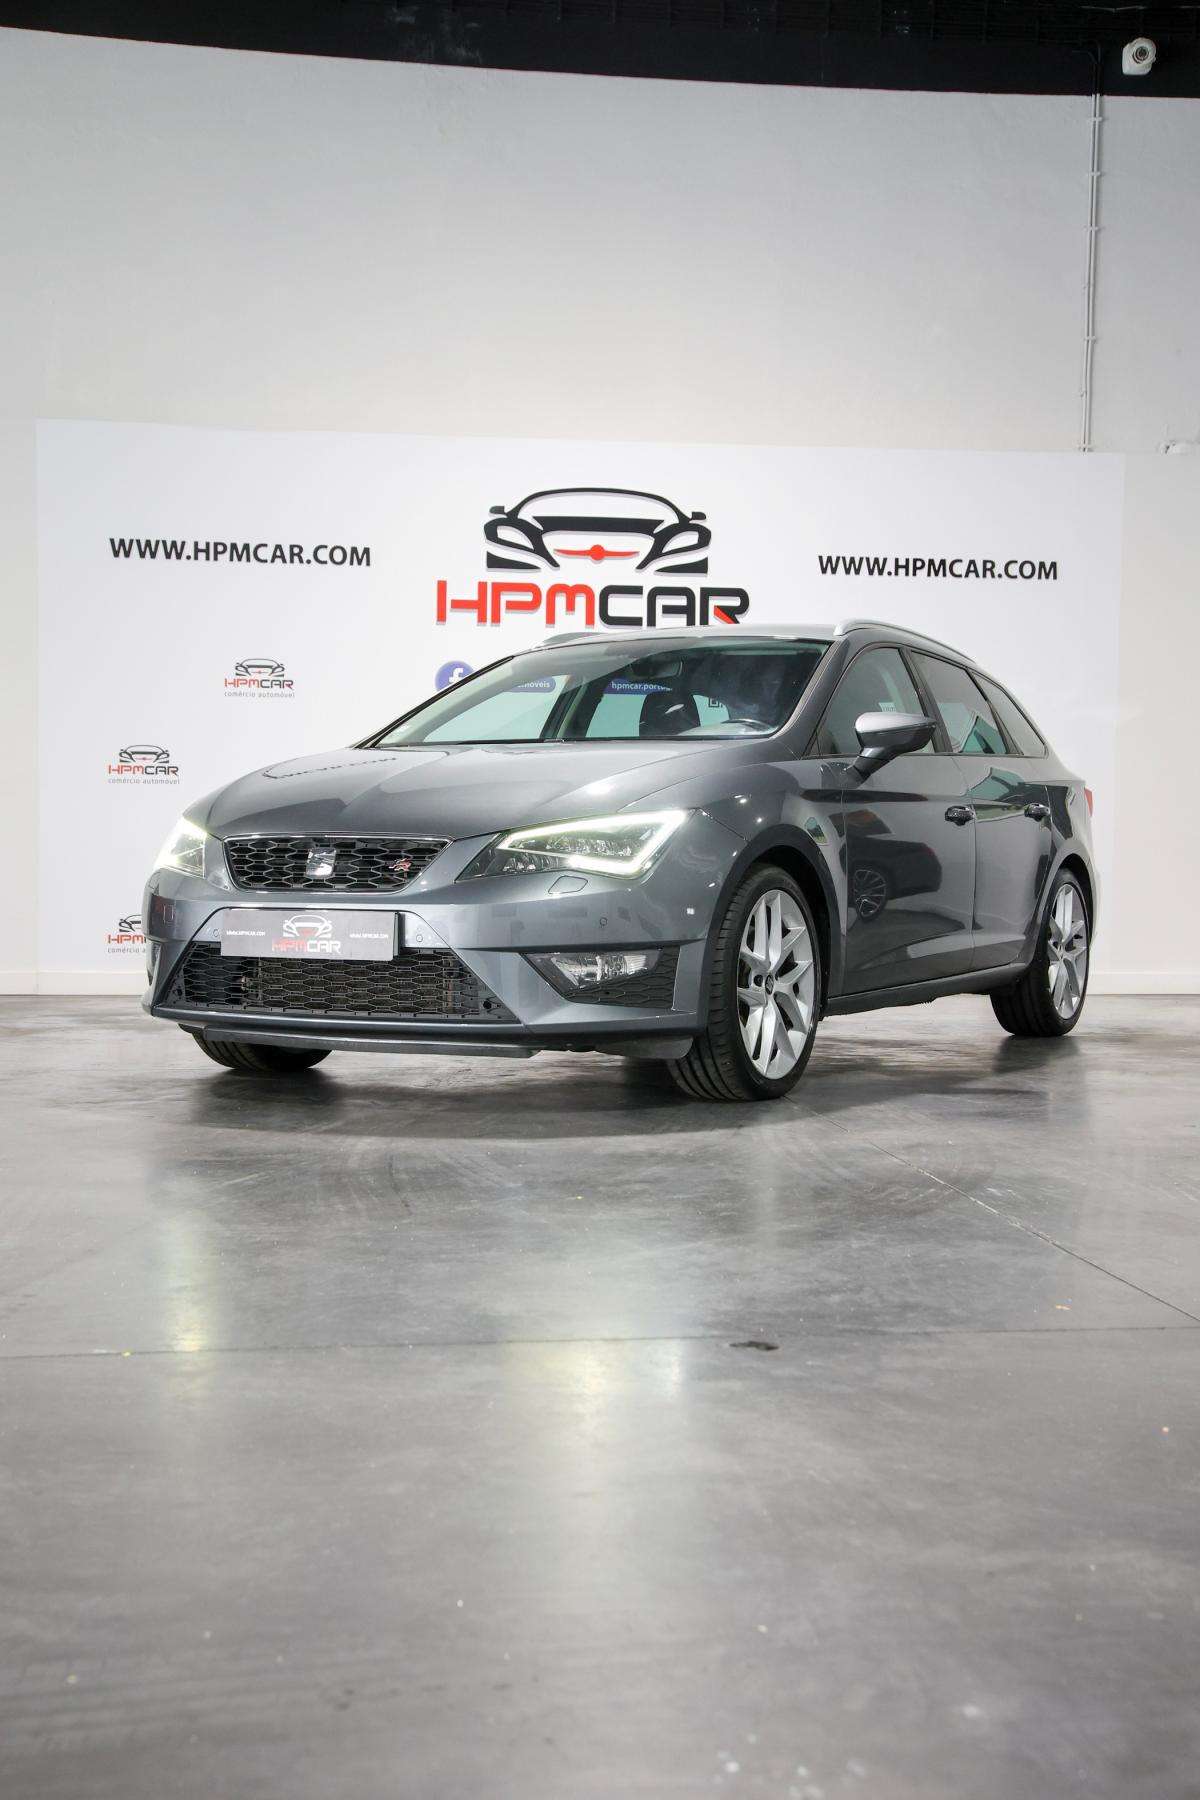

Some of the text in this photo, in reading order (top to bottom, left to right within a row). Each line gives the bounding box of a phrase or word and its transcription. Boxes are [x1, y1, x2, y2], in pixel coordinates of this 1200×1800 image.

[109, 537, 371, 566] WWW.HPMCAR.COM
[818, 555, 1058, 580] WWW.HPMCAR.COM
[435, 579, 750, 629] HPMCAR
[224, 678, 294, 690] HPMCAR
[108, 764, 179, 776] HPMCAR
[107, 934, 147, 944] HPM
